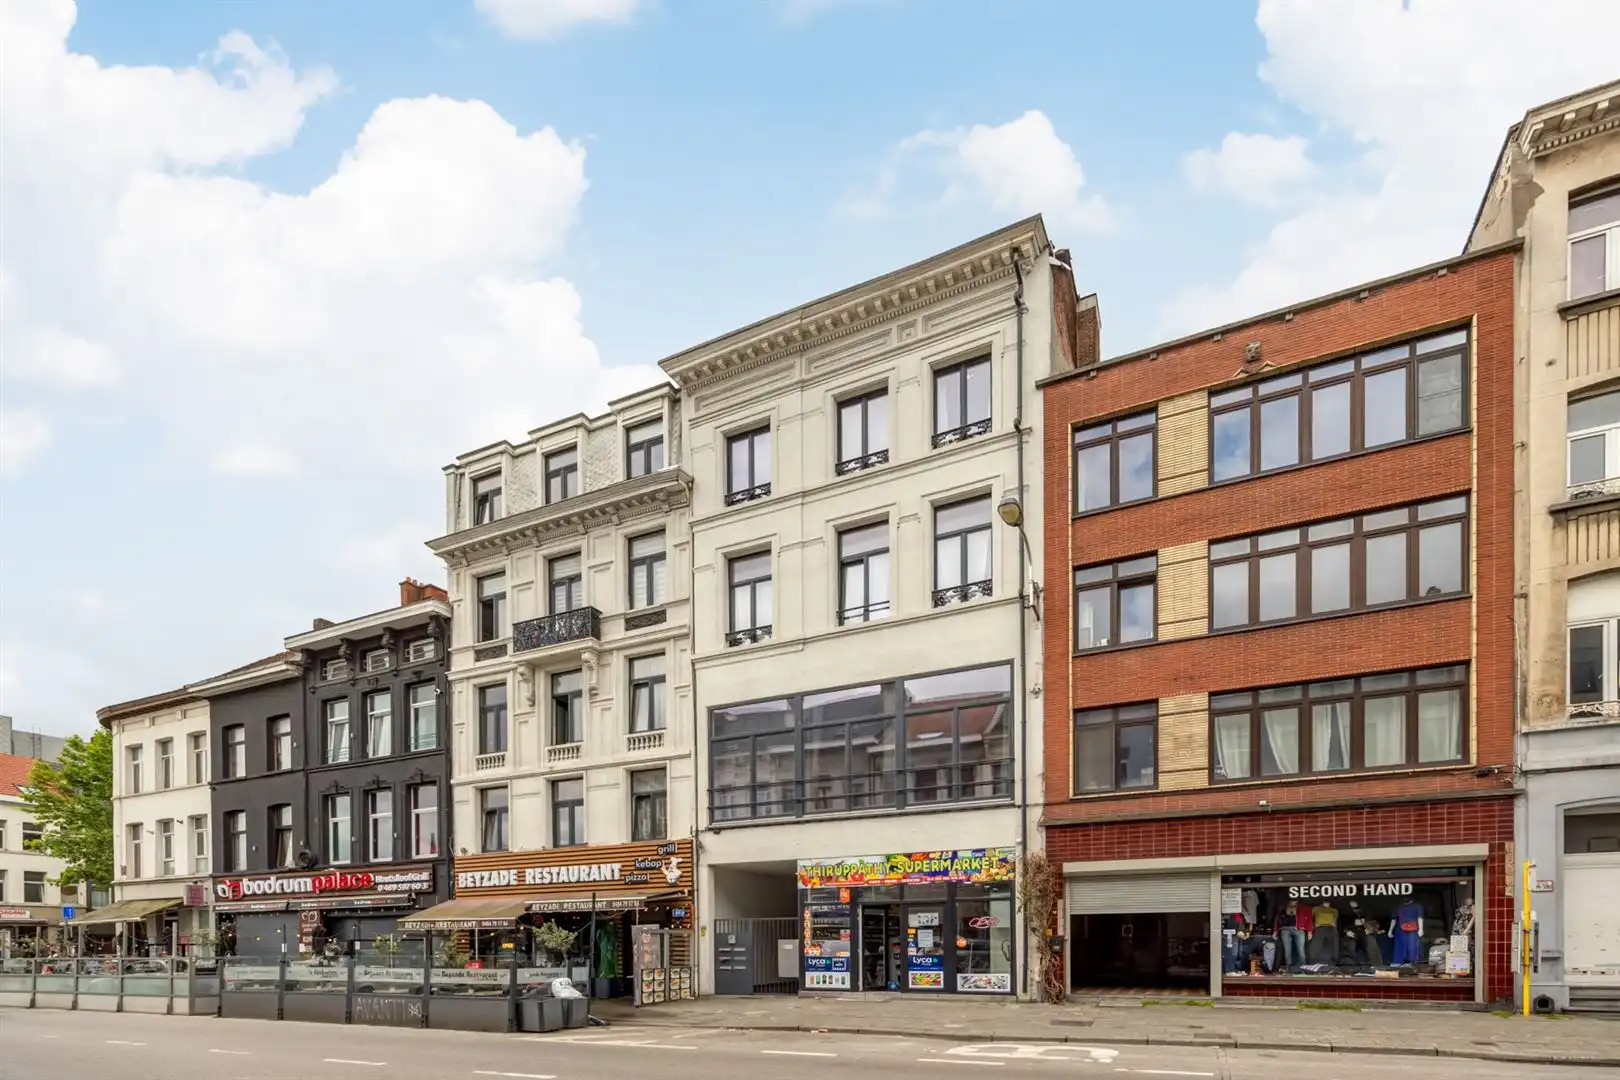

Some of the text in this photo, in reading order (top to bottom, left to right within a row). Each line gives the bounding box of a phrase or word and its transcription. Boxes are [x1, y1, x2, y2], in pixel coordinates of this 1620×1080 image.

[657, 844, 675, 856] grill
[804, 856, 999, 877] THIRUPPATHY SUPERMARKET
[458, 863, 622, 888] BEYZADE RESTAURANT
[625, 874, 647, 883] pizza
[1288, 883, 1413, 899] SECOND HAND
